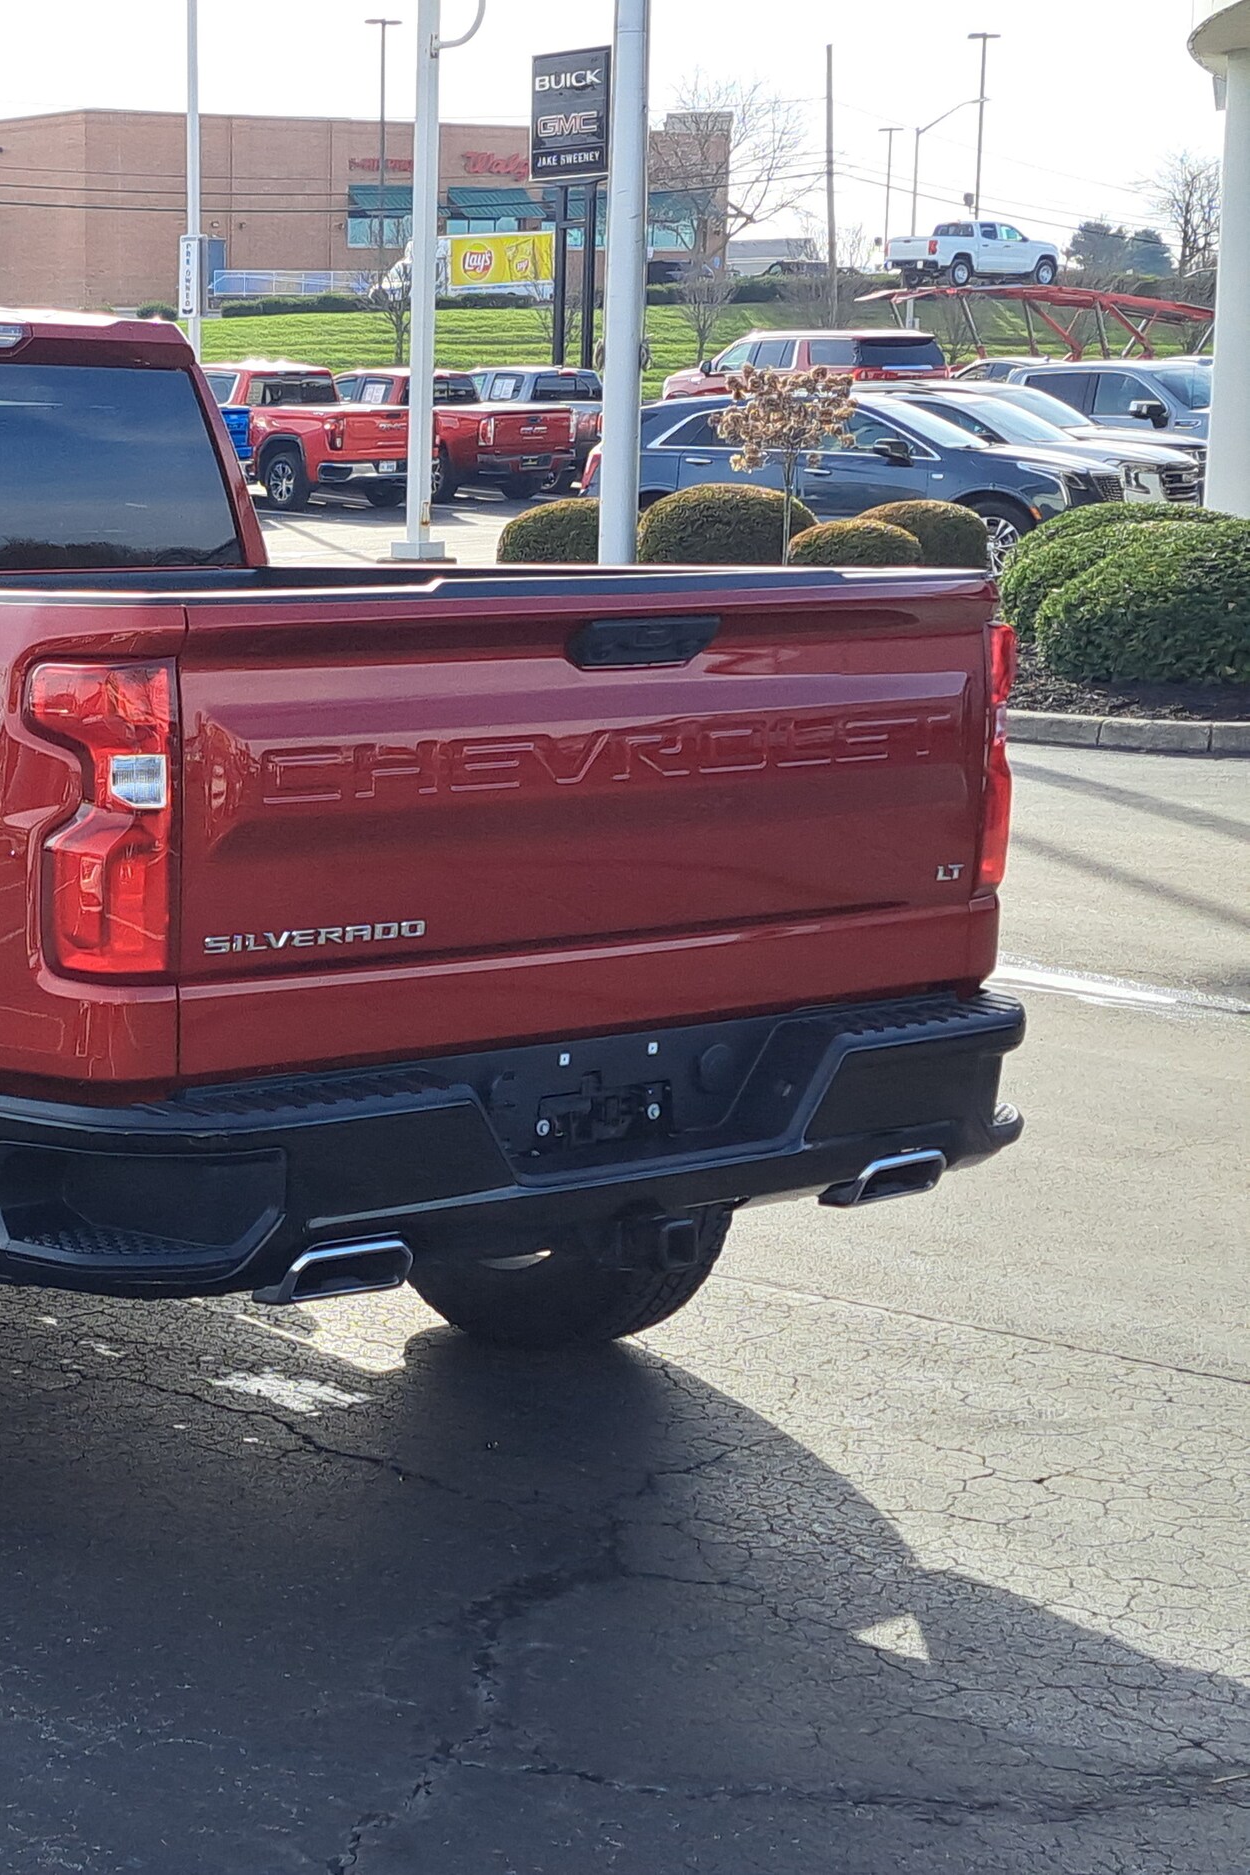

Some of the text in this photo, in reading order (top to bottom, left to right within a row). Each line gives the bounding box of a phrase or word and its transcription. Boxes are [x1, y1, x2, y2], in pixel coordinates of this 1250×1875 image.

[535, 68, 602, 91] BUICK
[538, 111, 597, 137] GMC
[461, 151, 529, 181] Walg
[537, 151, 600, 167] JAKE SWEENEY
[464, 249, 492, 273] Lay's
[261, 712, 952, 804] CHEVROLET
[936, 863, 965, 881] LT
[204, 919, 427, 954] SILVERADO
